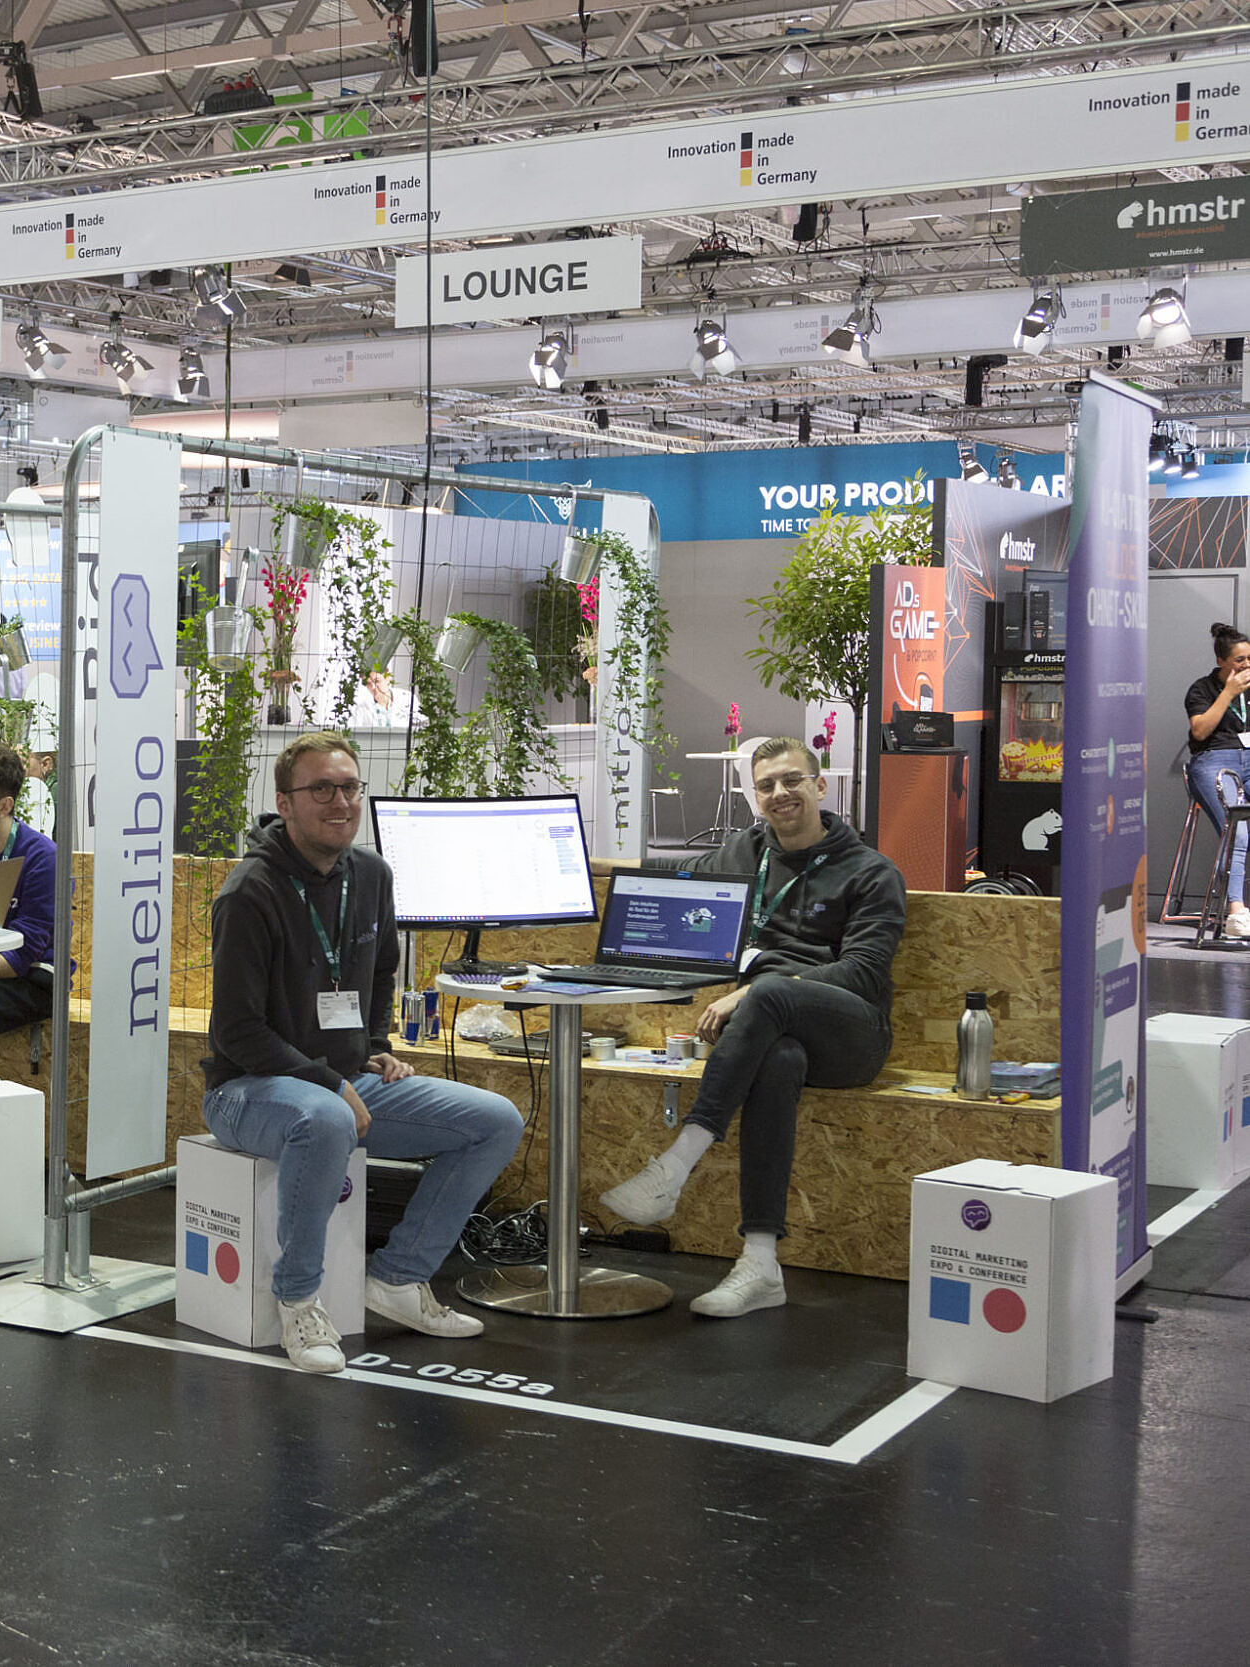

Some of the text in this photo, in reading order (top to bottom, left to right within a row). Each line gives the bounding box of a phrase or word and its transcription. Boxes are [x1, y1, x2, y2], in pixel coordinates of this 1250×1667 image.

[1196, 82, 1240, 100] made
[1088, 91, 1170, 112] Innovation
[1196, 107, 1210, 120] in
[758, 132, 794, 148] made
[1195, 124, 1250, 140] Germa
[668, 140, 736, 159] Innovation
[757, 154, 769, 167] in
[390, 175, 421, 190] made
[757, 169, 817, 185] Germany
[314, 182, 372, 199] Innovation
[390, 195, 400, 207] in
[390, 210, 441, 224] Germany
[1147, 195, 1246, 226] hmstr
[12, 220, 63, 235] Innovation
[77, 214, 105, 227] made
[78, 232, 87, 243] in
[78, 245, 122, 259] Germany
[1148, 247, 1204, 258] www.hmstr.de
[443, 261, 588, 302] LOUNGE
[759, 484, 838, 510] YOUR
[761, 519, 792, 533] TIME
[1008, 532, 1036, 561] hmstr
[122, 735, 164, 1036] melibo
[931, 1244, 1028, 1269] DIGITAL MARKETING
[931, 1260, 953, 1271] EXPO
[969, 1267, 1027, 1284] CONFERENCE
[349, 1352, 554, 1396] D-055a
